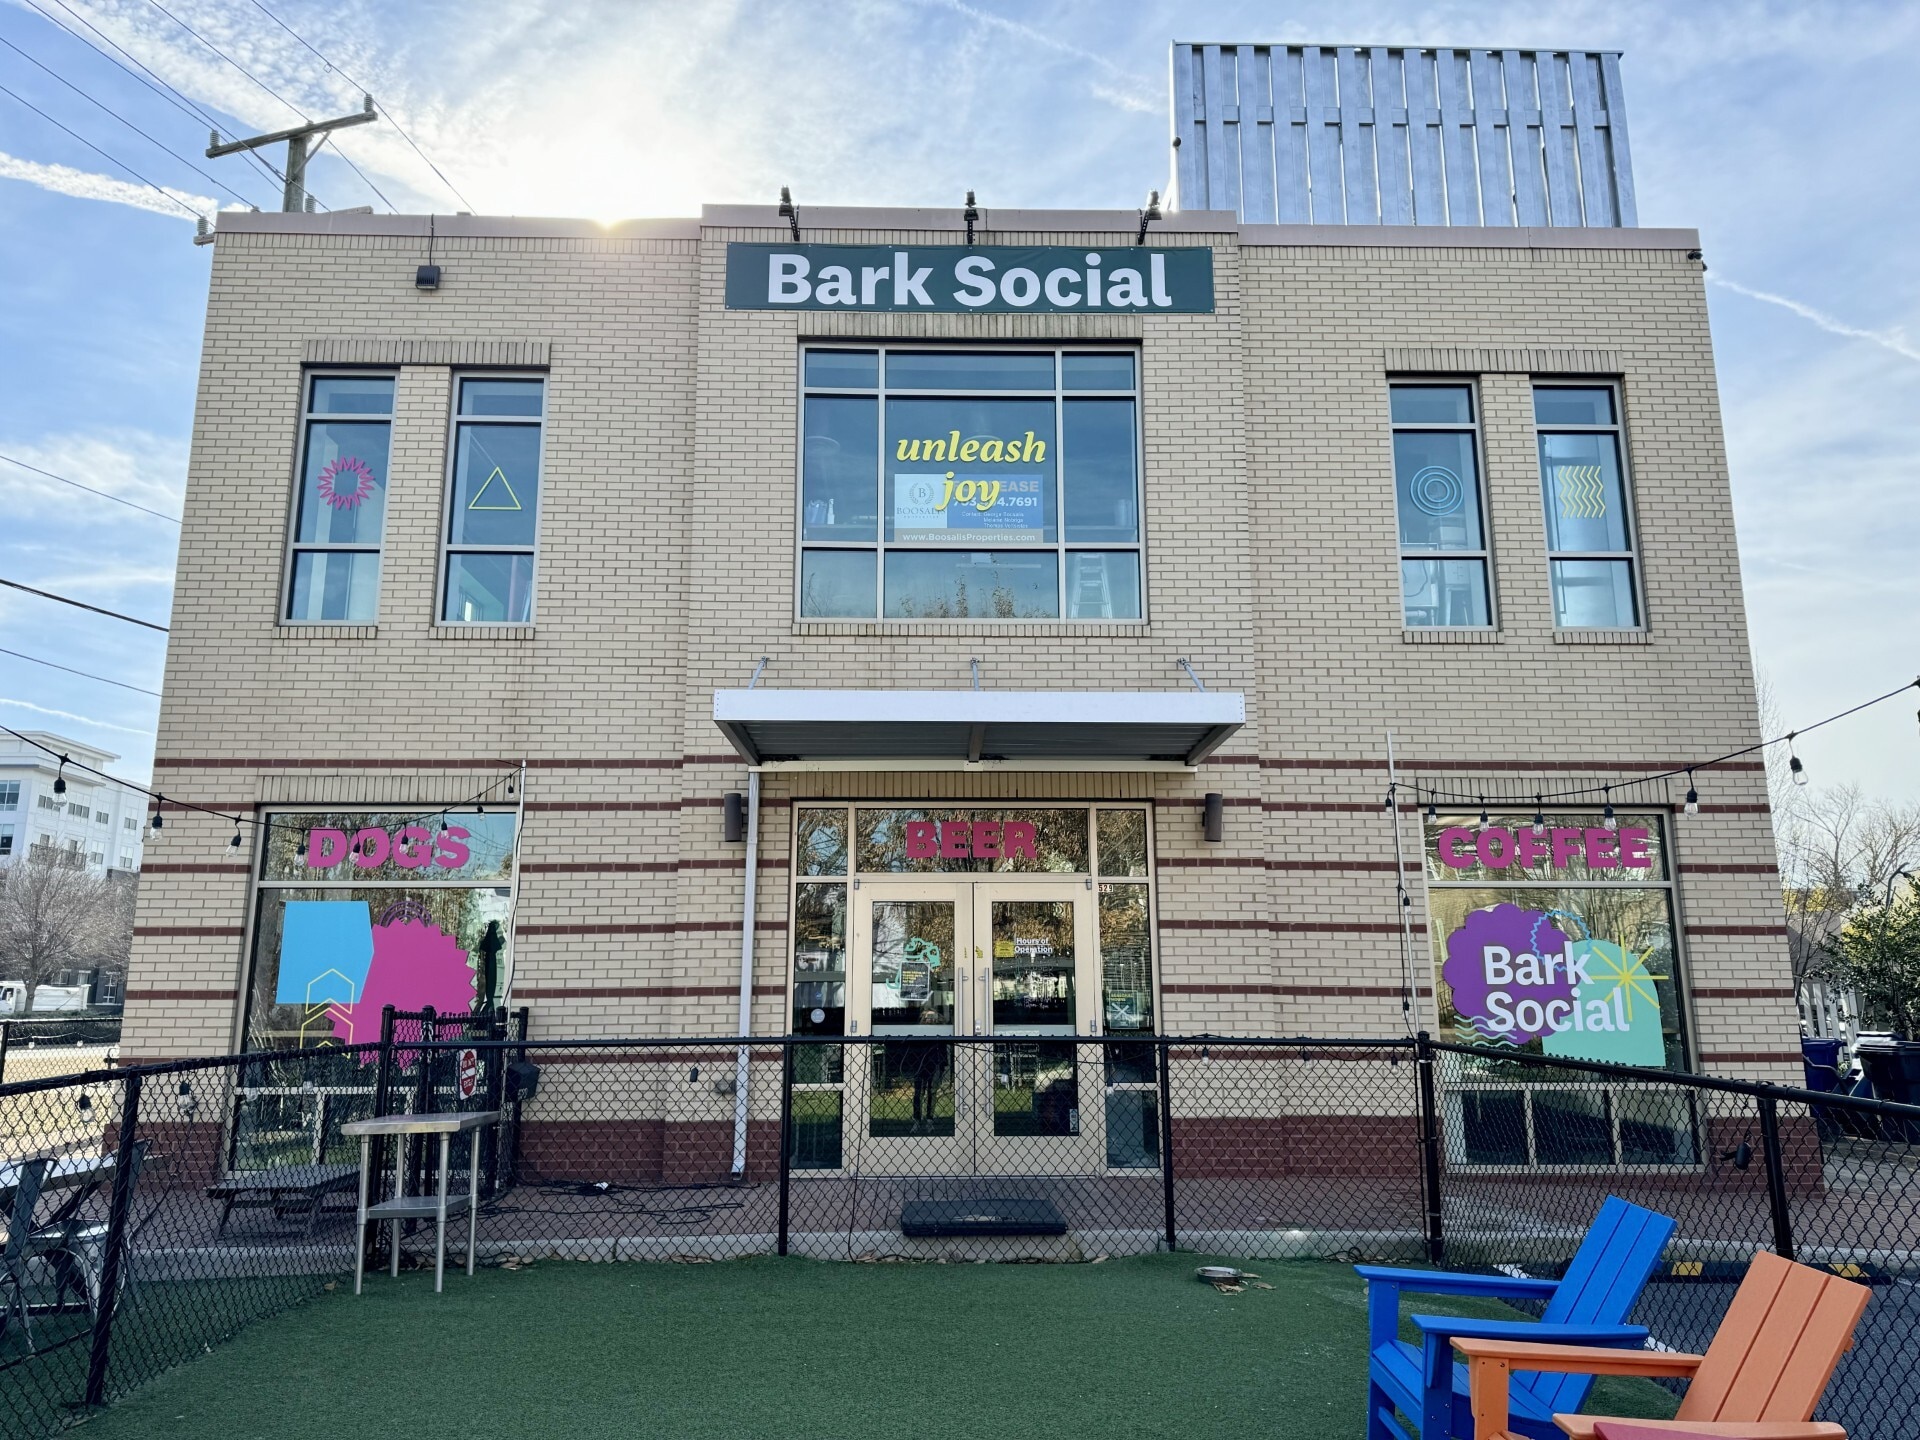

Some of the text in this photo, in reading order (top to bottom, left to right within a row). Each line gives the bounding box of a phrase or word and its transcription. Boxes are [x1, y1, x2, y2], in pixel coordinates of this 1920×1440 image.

[768, 252, 1173, 307] Bark Social
[897, 430, 1046, 463] unleash
[918, 487, 926, 498] B
[935, 471, 1001, 511] joy
[307, 827, 471, 869] DOGS
[906, 821, 1037, 860] BEER
[1437, 827, 1652, 869] COFFEE
[1098, 884, 1112, 892] 529
[1014, 945, 1053, 955] Operation
[1016, 937, 1049, 945] Hours of
[1483, 941, 1594, 985] Bark
[1486, 987, 1630, 1032] Social
